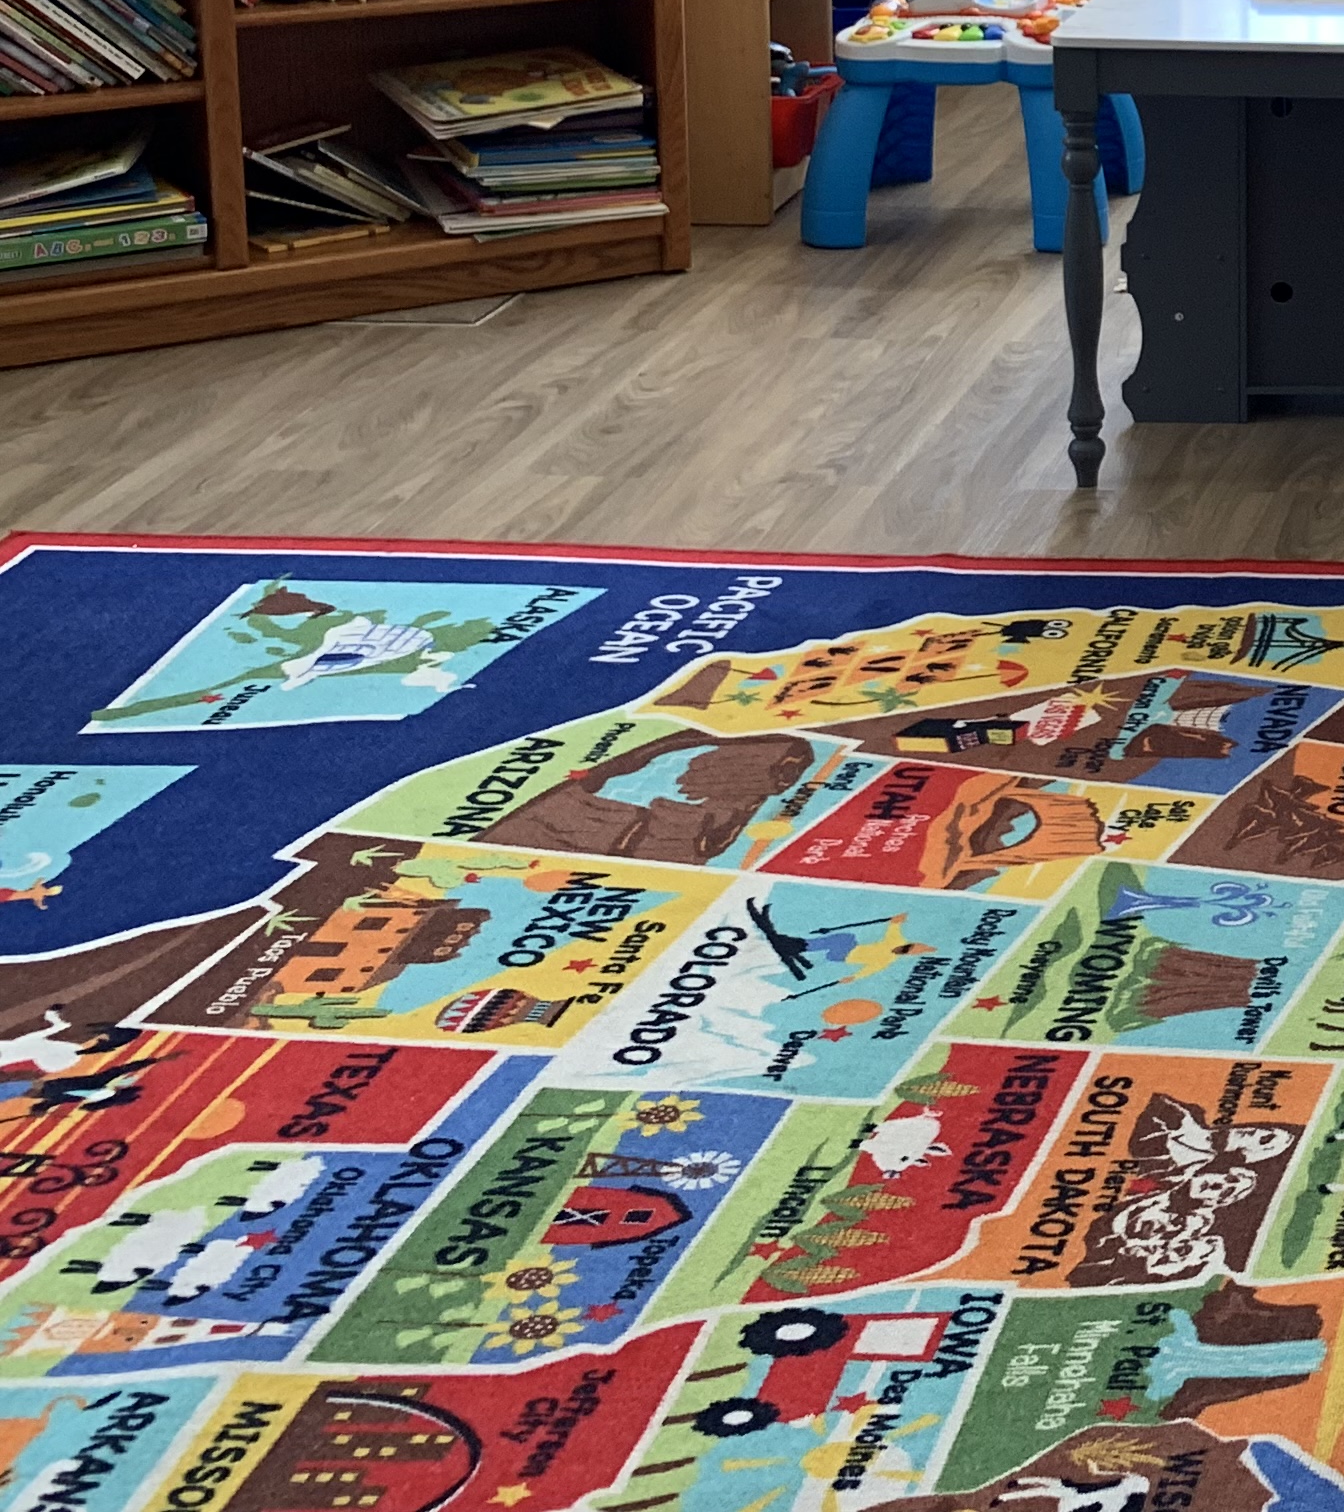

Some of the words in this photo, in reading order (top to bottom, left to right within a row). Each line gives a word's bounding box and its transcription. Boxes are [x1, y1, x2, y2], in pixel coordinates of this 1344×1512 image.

[483, 585, 579, 645] ALASKA
[589, 593, 699, 667] OCEAN
[665, 574, 784, 656] PACIFIC
[1133, 615, 1180, 664] Sacramento
[1066, 608, 1139, 684] CALIFORNIA
[201, 683, 272, 728] Juneau
[1136, 676, 1167, 709] Carson
[1249, 684, 1312, 753] NEVADA
[577, 721, 638, 764] Phoenix
[1117, 711, 1151, 733] City
[431, 735, 567, 841] ARIZONA
[828, 761, 874, 792] Grand
[863, 767, 936, 821] UTAH
[881, 813, 932, 853] Arches
[1107, 809, 1143, 832] City
[1137, 802, 1173, 829] Lake
[1165, 800, 1196, 822] Salt
[798, 837, 844, 865] Park
[497, 870, 612, 970] MEXICO
[567, 885, 649, 945] NEW
[960, 908, 1018, 947] Rocky
[253, 932, 310, 971] Taos
[600, 918, 666, 976] Santa
[938, 947, 998, 1000] Mountain
[1008, 939, 1064, 1005] Cheyenne
[204, 967, 275, 1017] Pueblo
[574, 978, 626, 1006] Fe
[611, 924, 749, 1067] COLORADO
[894, 955, 953, 1006] National
[1044, 914, 1145, 1043] WYOMING
[1249, 954, 1290, 1000] Devil's
[870, 1007, 924, 1041] Park
[1234, 1002, 1273, 1045] Tower
[761, 1029, 819, 1083] Denver
[276, 1046, 400, 1142] TEXAS
[1064, 1074, 1135, 1159] SOUTH
[1243, 1067, 1294, 1113] Mount
[940, 1054, 1061, 1211] NEBRASKA
[264, 1166, 367, 1260] Oklahoma
[432, 1134, 576, 1270] KANSAS
[758, 1164, 834, 1238] Lincoln
[1090, 1158, 1141, 1214] Pierre
[280, 1136, 468, 1325] OKLAHOMA
[1009, 1166, 1098, 1277] DAKOTA
[222, 1262, 289, 1305] City
[609, 1232, 682, 1302] Topeka
[925, 1291, 1006, 1379] IOWA
[1125, 1300, 1174, 1335] St.
[869, 1368, 924, 1406] Des
[1000, 1341, 1063, 1389] Falls
[1034, 1318, 1123, 1431] Minnehaha
[1106, 1344, 1161, 1392] Paul
[500, 1396, 560, 1444] City
[516, 1368, 618, 1478] Jefferson
[160, 1400, 283, 1512] MISSO
[832, 1412, 901, 1491] Moines
[1151, 1448, 1209, 1512] WIS
